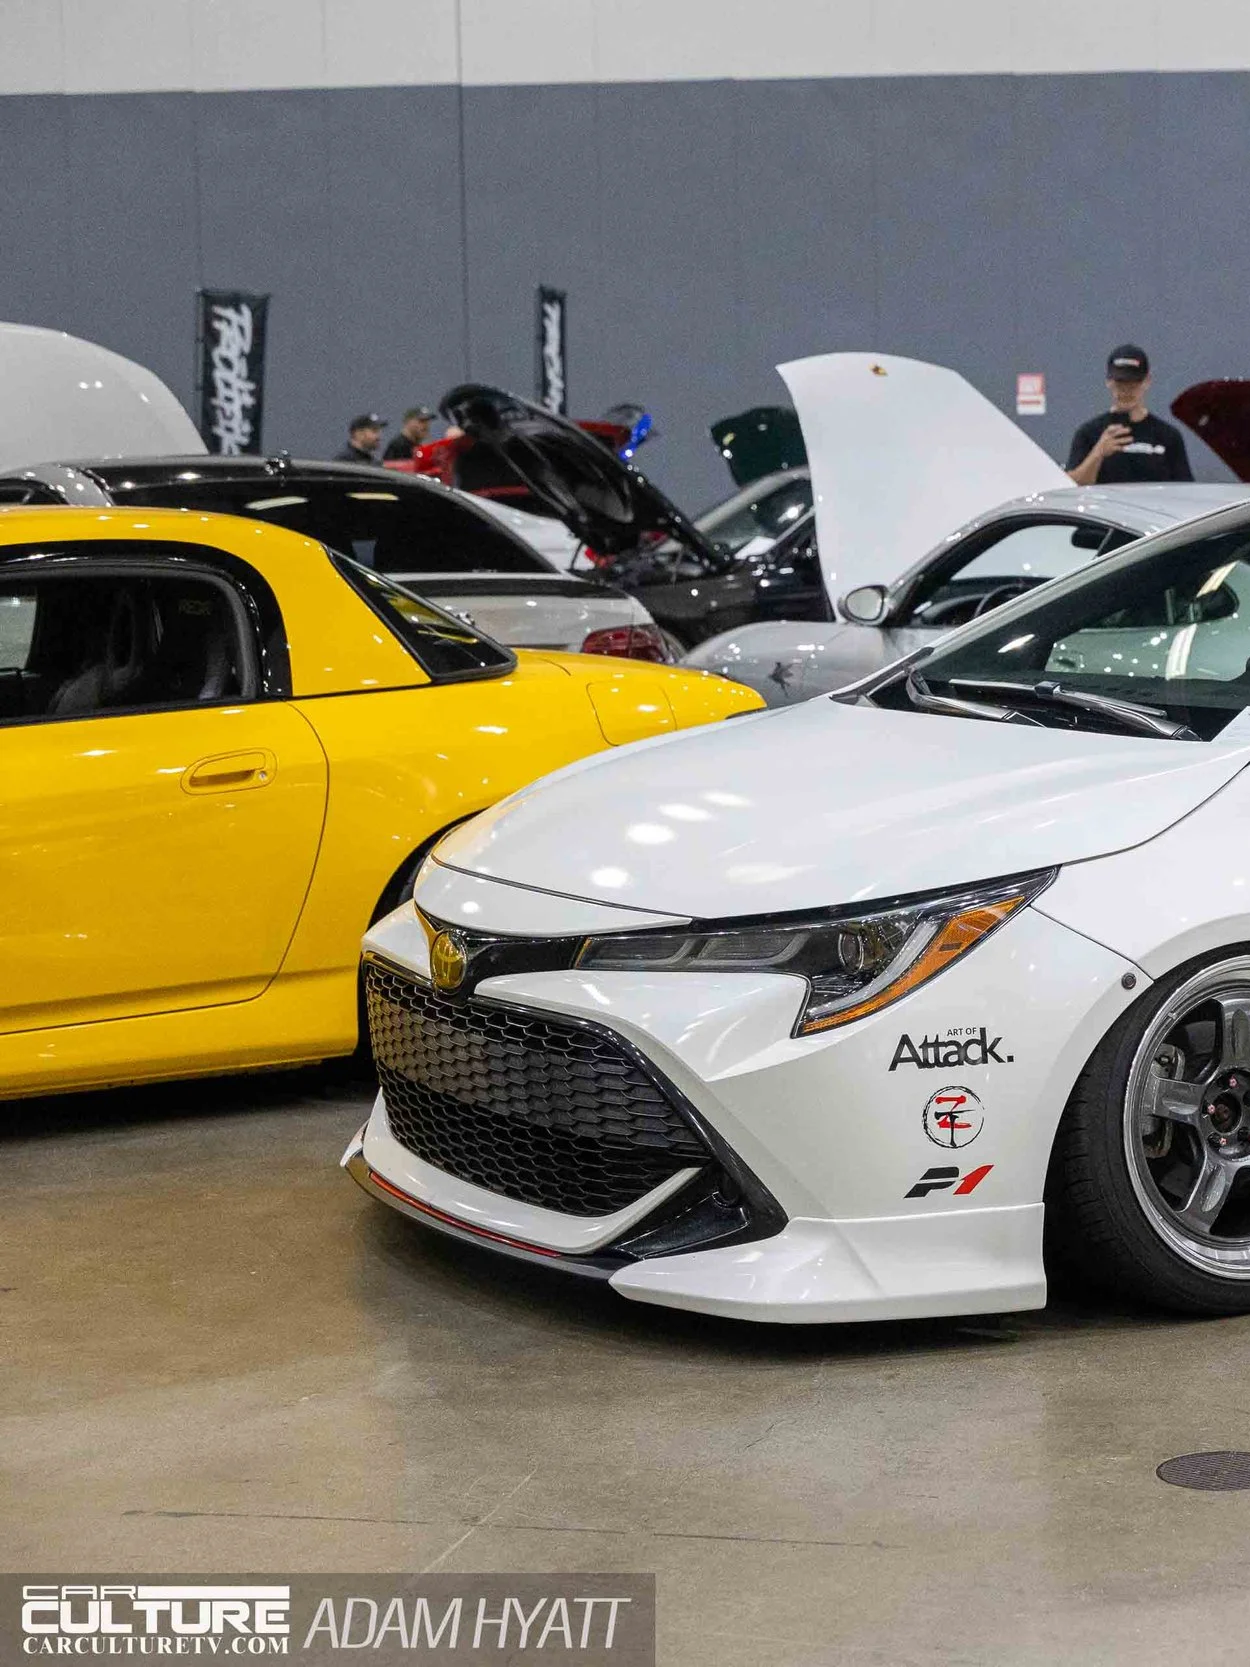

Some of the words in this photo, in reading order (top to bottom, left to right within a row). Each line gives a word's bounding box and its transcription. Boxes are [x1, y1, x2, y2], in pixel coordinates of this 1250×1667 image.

[888, 1027, 1014, 1071] Attack.
[947, 1028, 963, 1037] ART
[965, 1027, 977, 1036] OF
[903, 1164, 995, 1199] P1
